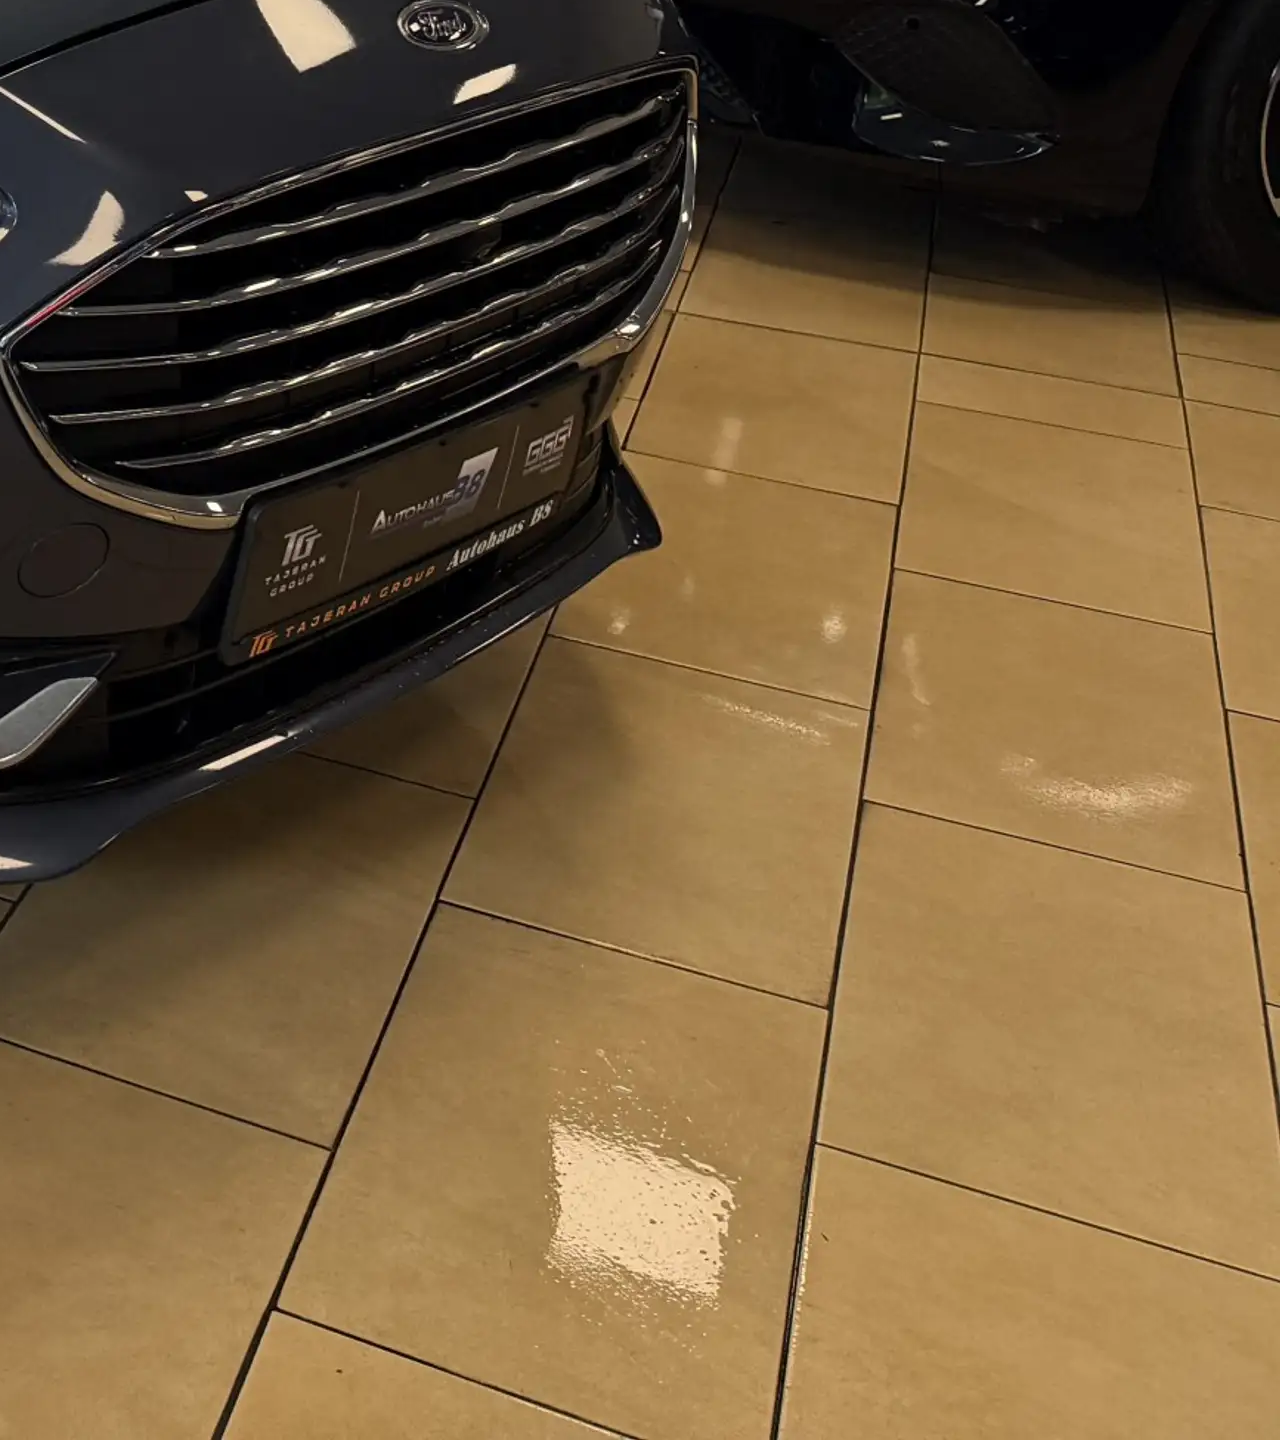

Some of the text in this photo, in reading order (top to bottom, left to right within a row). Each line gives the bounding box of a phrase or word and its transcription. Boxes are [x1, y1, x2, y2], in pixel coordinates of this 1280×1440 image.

[264, 555, 326, 585] TAJERAN
[269, 573, 314, 597] GROUP
[285, 594, 371, 638] TAJERAN
[379, 564, 436, 598] GROUP
[446, 520, 526, 571] Autohaus
